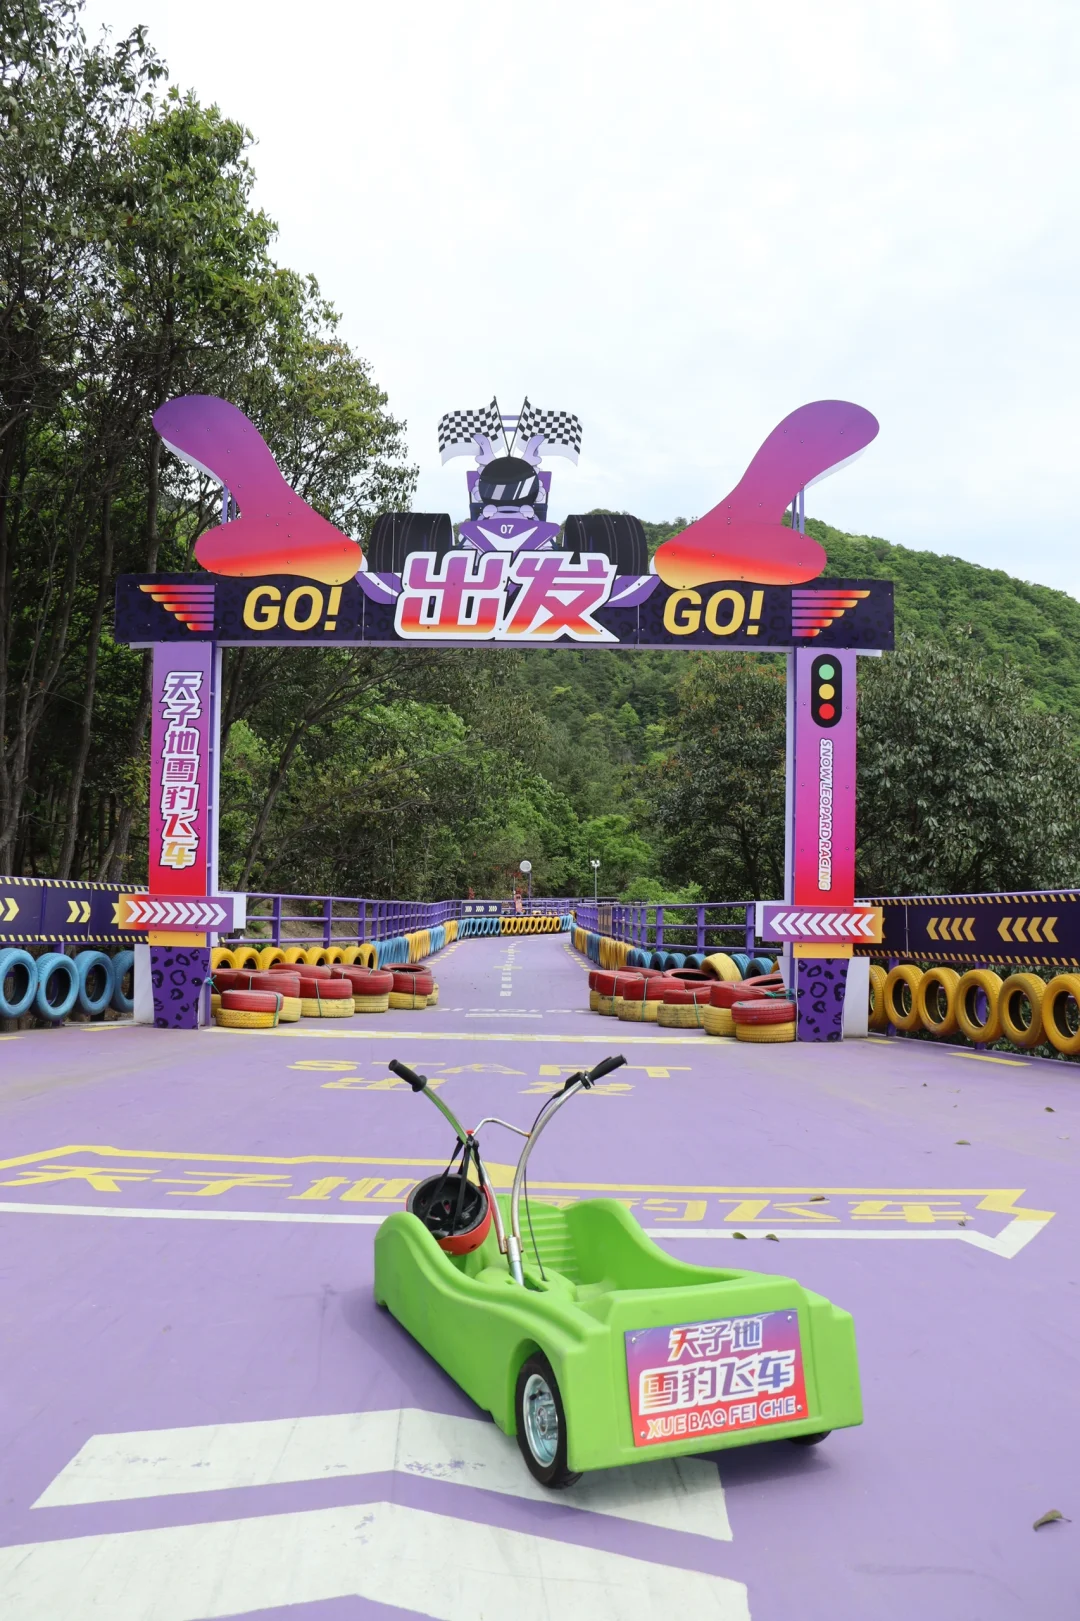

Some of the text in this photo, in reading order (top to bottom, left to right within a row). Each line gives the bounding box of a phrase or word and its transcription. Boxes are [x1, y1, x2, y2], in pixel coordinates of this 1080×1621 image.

[500, 524, 514, 535] 07
[243, 586, 343, 631] GO!
[396, 552, 618, 640] 出发
[663, 589, 764, 635] GO!
[162, 672, 202, 868] 天子地雪豹飞车
[0, 1165, 974, 1223] 天子地豹飞车
[669, 1319, 762, 1361] 天子地
[641, 1352, 795, 1414] 雪豹飞车
[647, 1396, 796, 1439] XUE BAO FEI CHE
